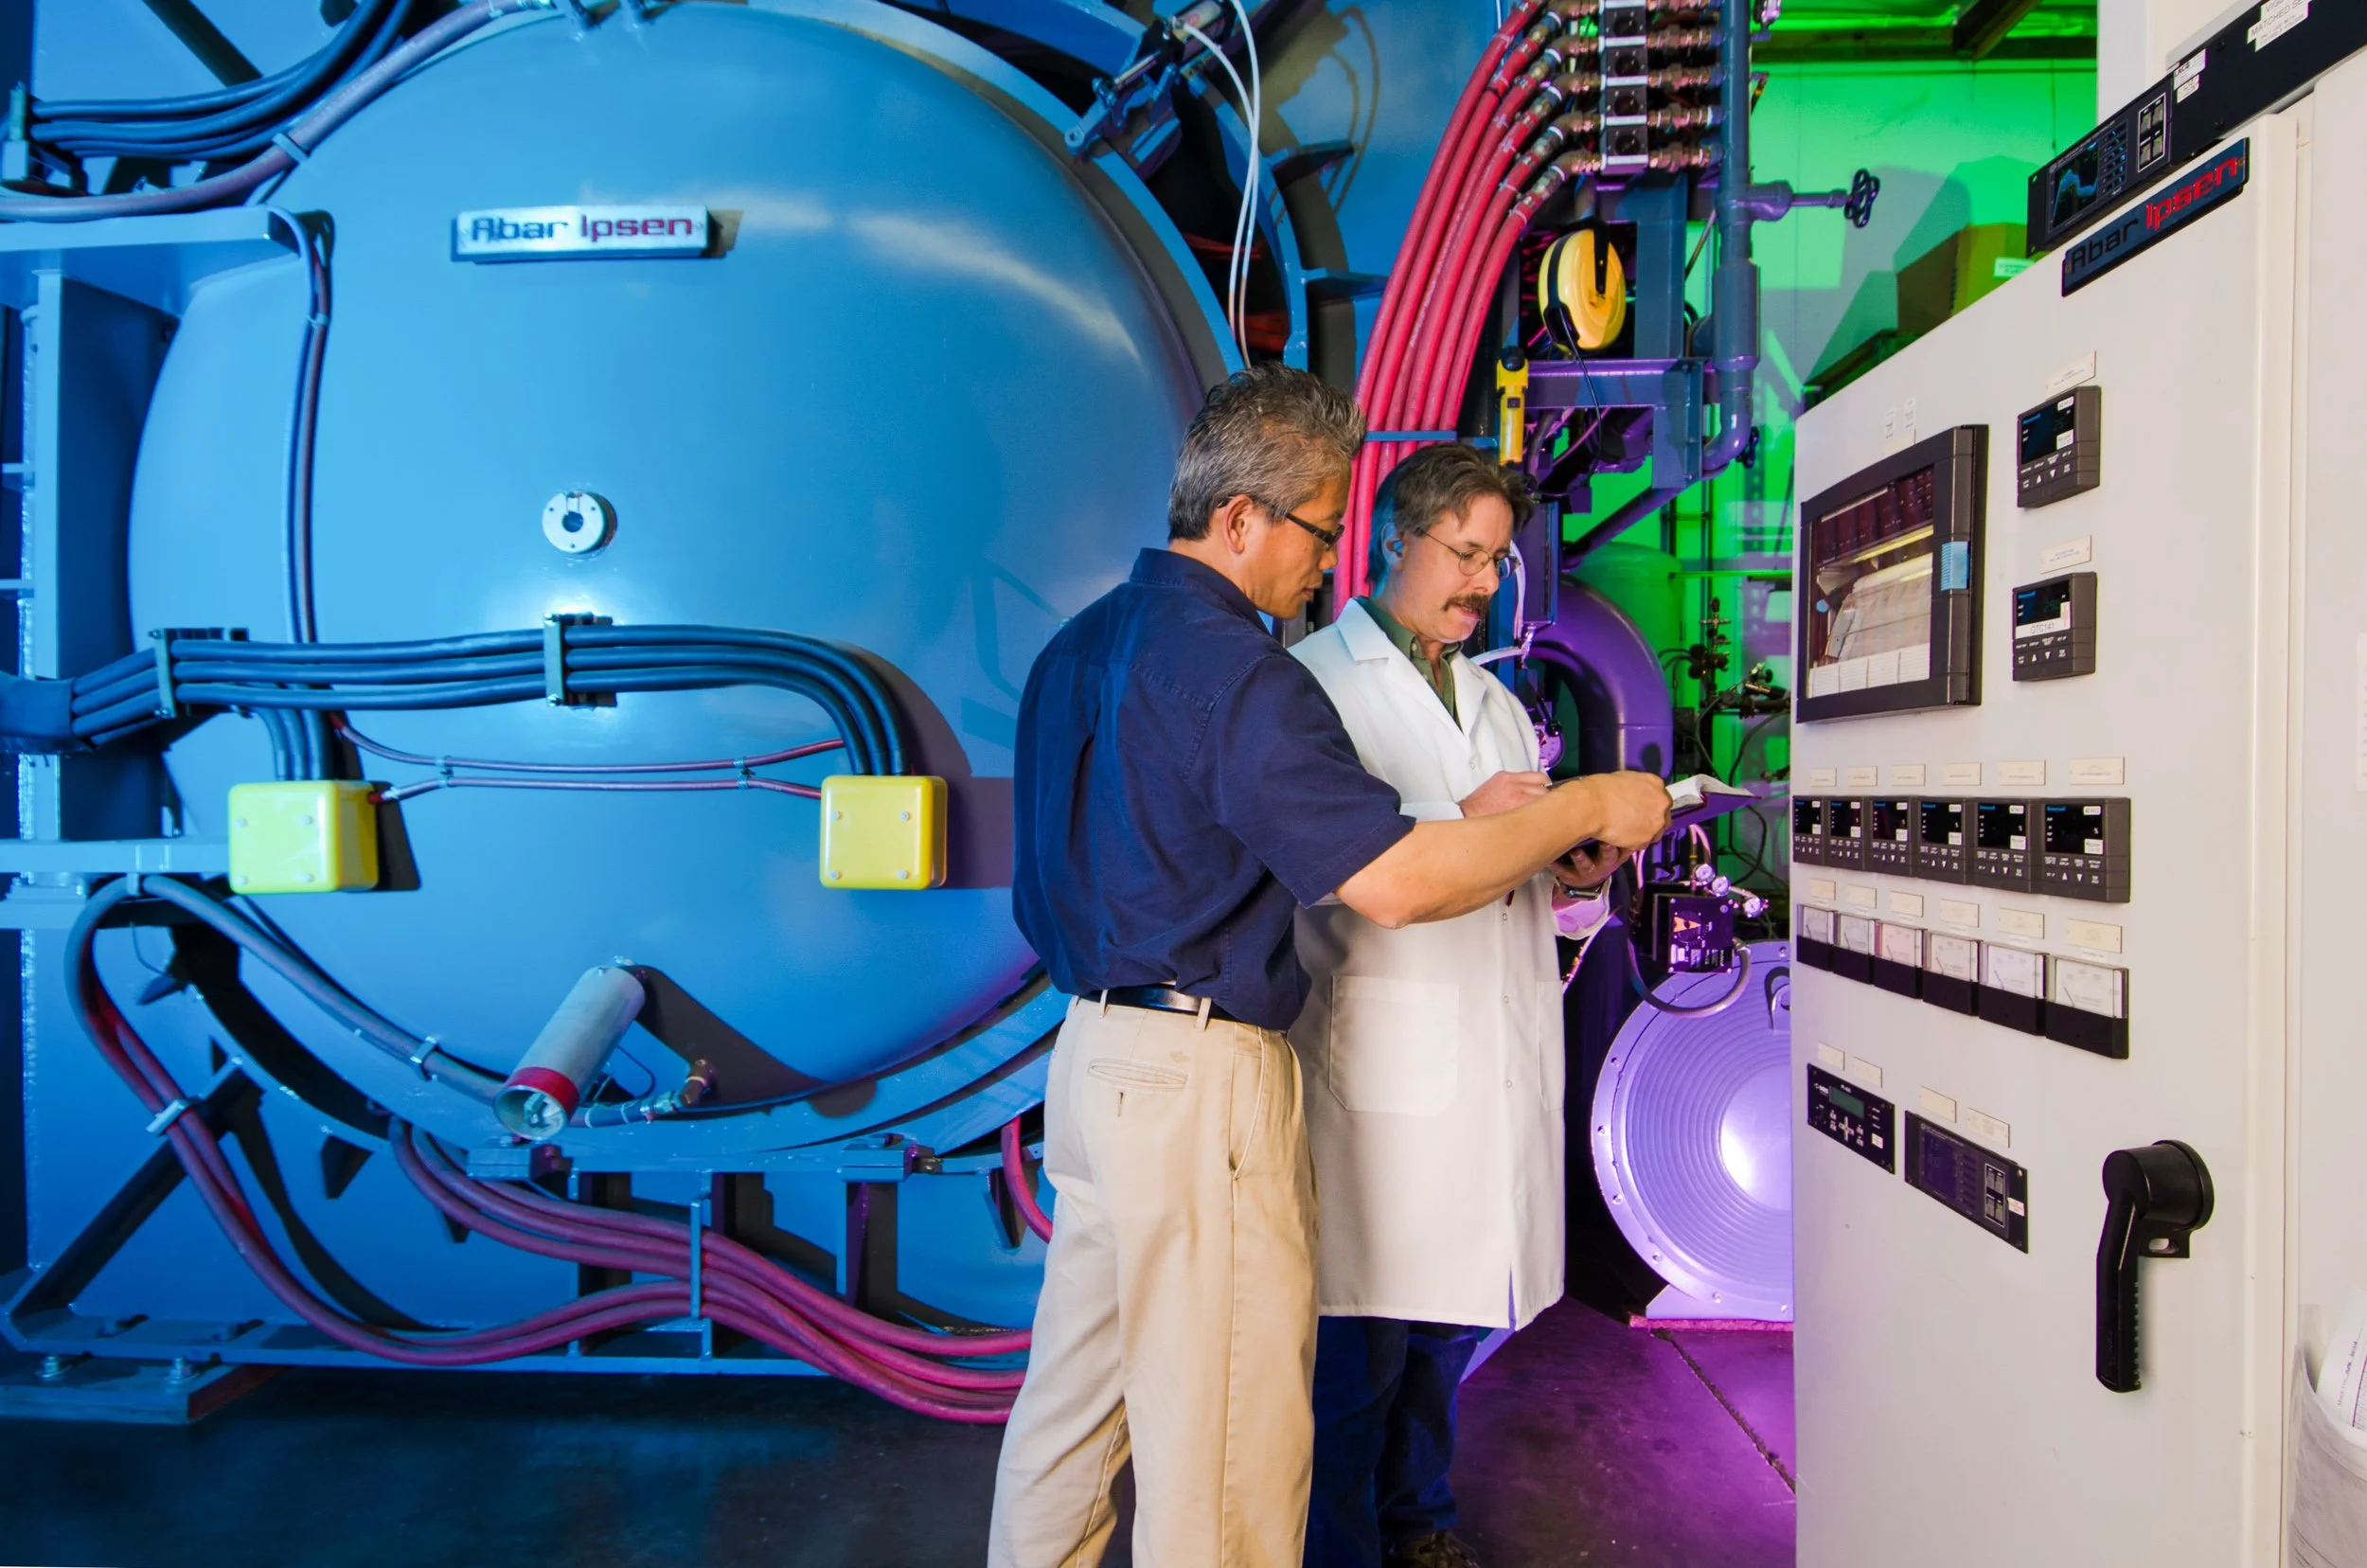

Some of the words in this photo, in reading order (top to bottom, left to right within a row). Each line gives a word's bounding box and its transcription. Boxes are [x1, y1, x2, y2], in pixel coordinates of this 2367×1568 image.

[2251, 5, 2291, 37] MATCHED
[472, 217, 568, 241] Abar
[581, 214, 692, 243] Ipsen
[2071, 219, 2138, 275] Abar
[2145, 157, 2237, 230] Ipsen
